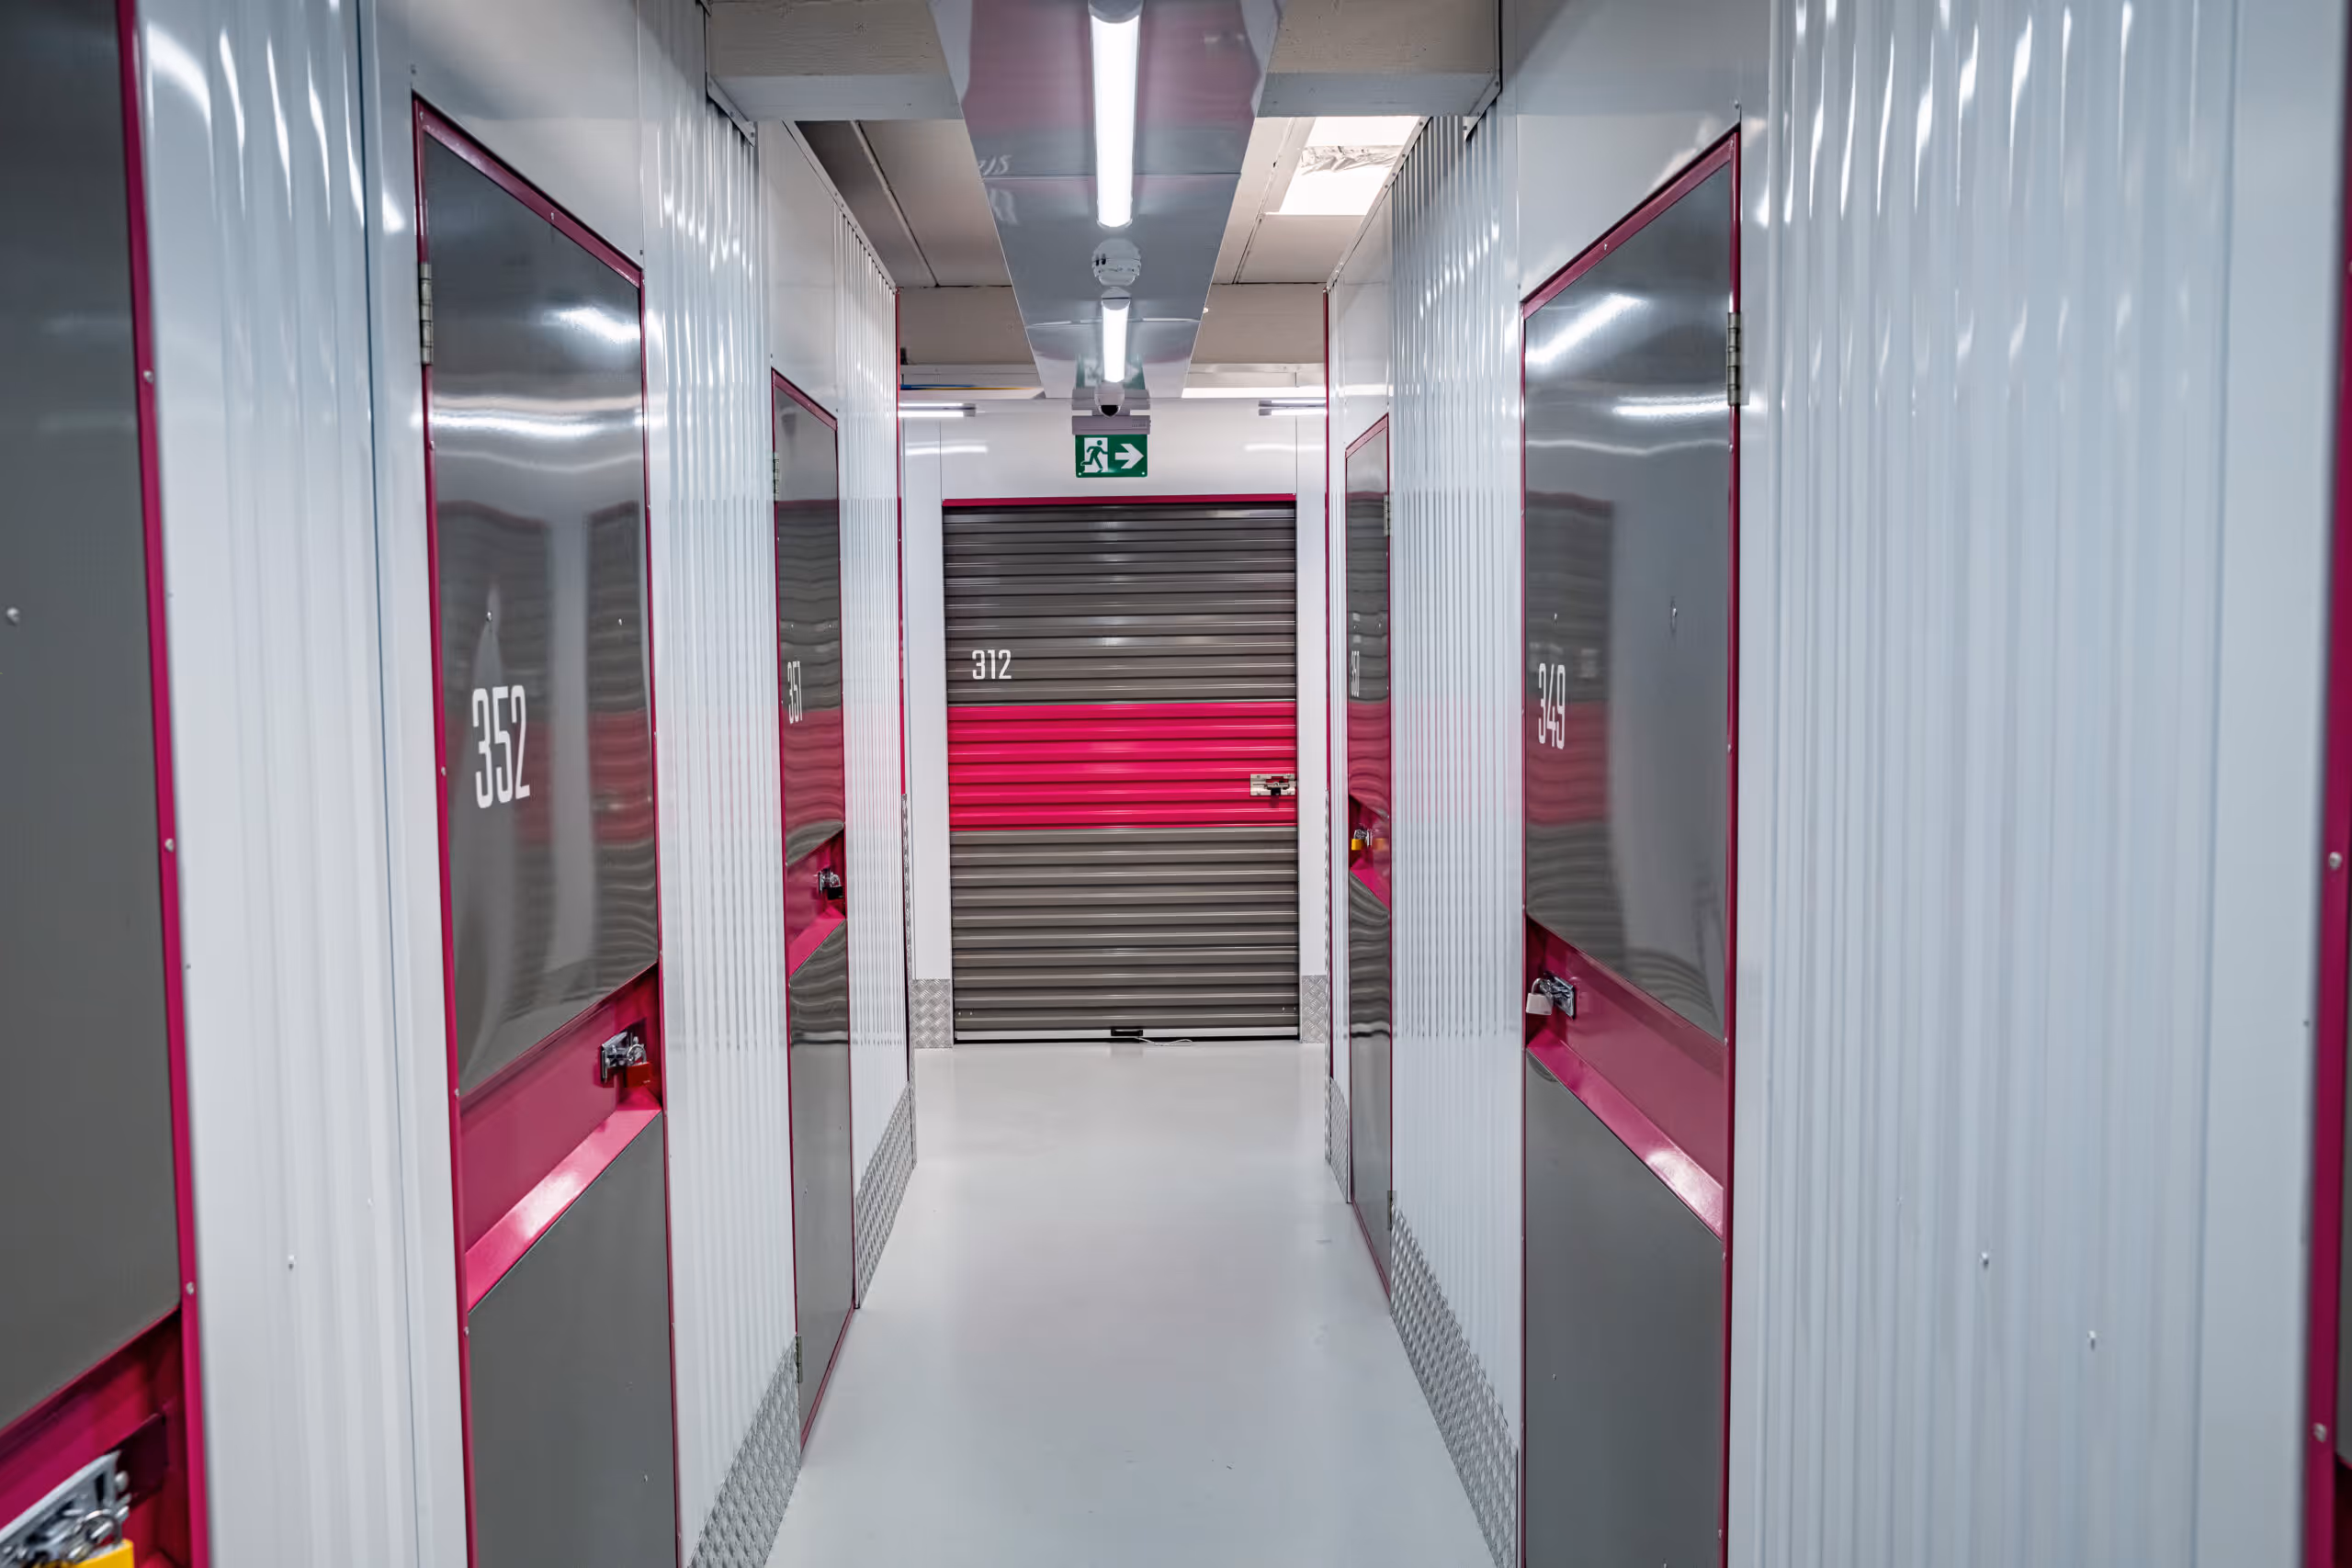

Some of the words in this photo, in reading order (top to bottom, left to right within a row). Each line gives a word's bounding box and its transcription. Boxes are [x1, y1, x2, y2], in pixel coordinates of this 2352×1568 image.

[787, 660, 803, 724] 351
[972, 649, 1012, 680] 312
[1538, 662, 1566, 750] 349
[472, 685, 530, 808] 352
